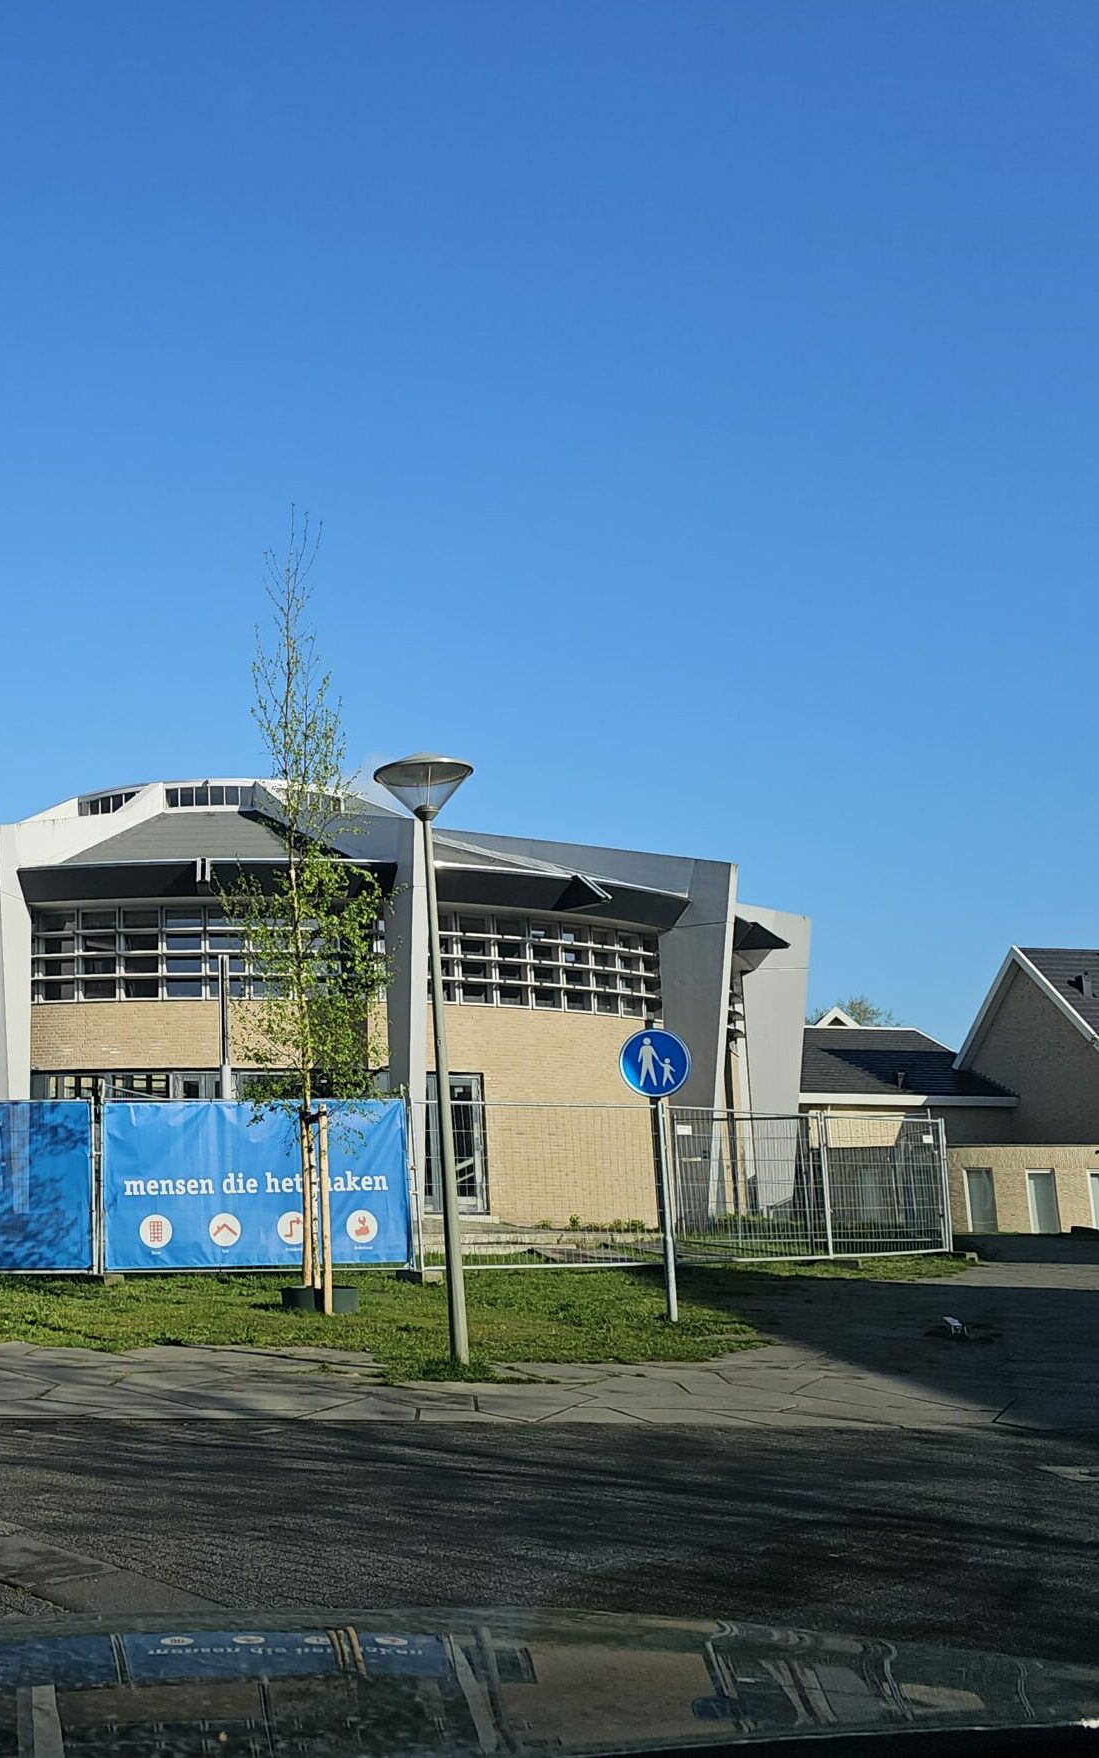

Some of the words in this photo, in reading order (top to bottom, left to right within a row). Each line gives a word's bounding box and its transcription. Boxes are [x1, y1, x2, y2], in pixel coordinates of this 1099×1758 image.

[124, 1177, 215, 1196] mensen
[222, 1173, 258, 1195] die
[265, 1172, 302, 1194] het
